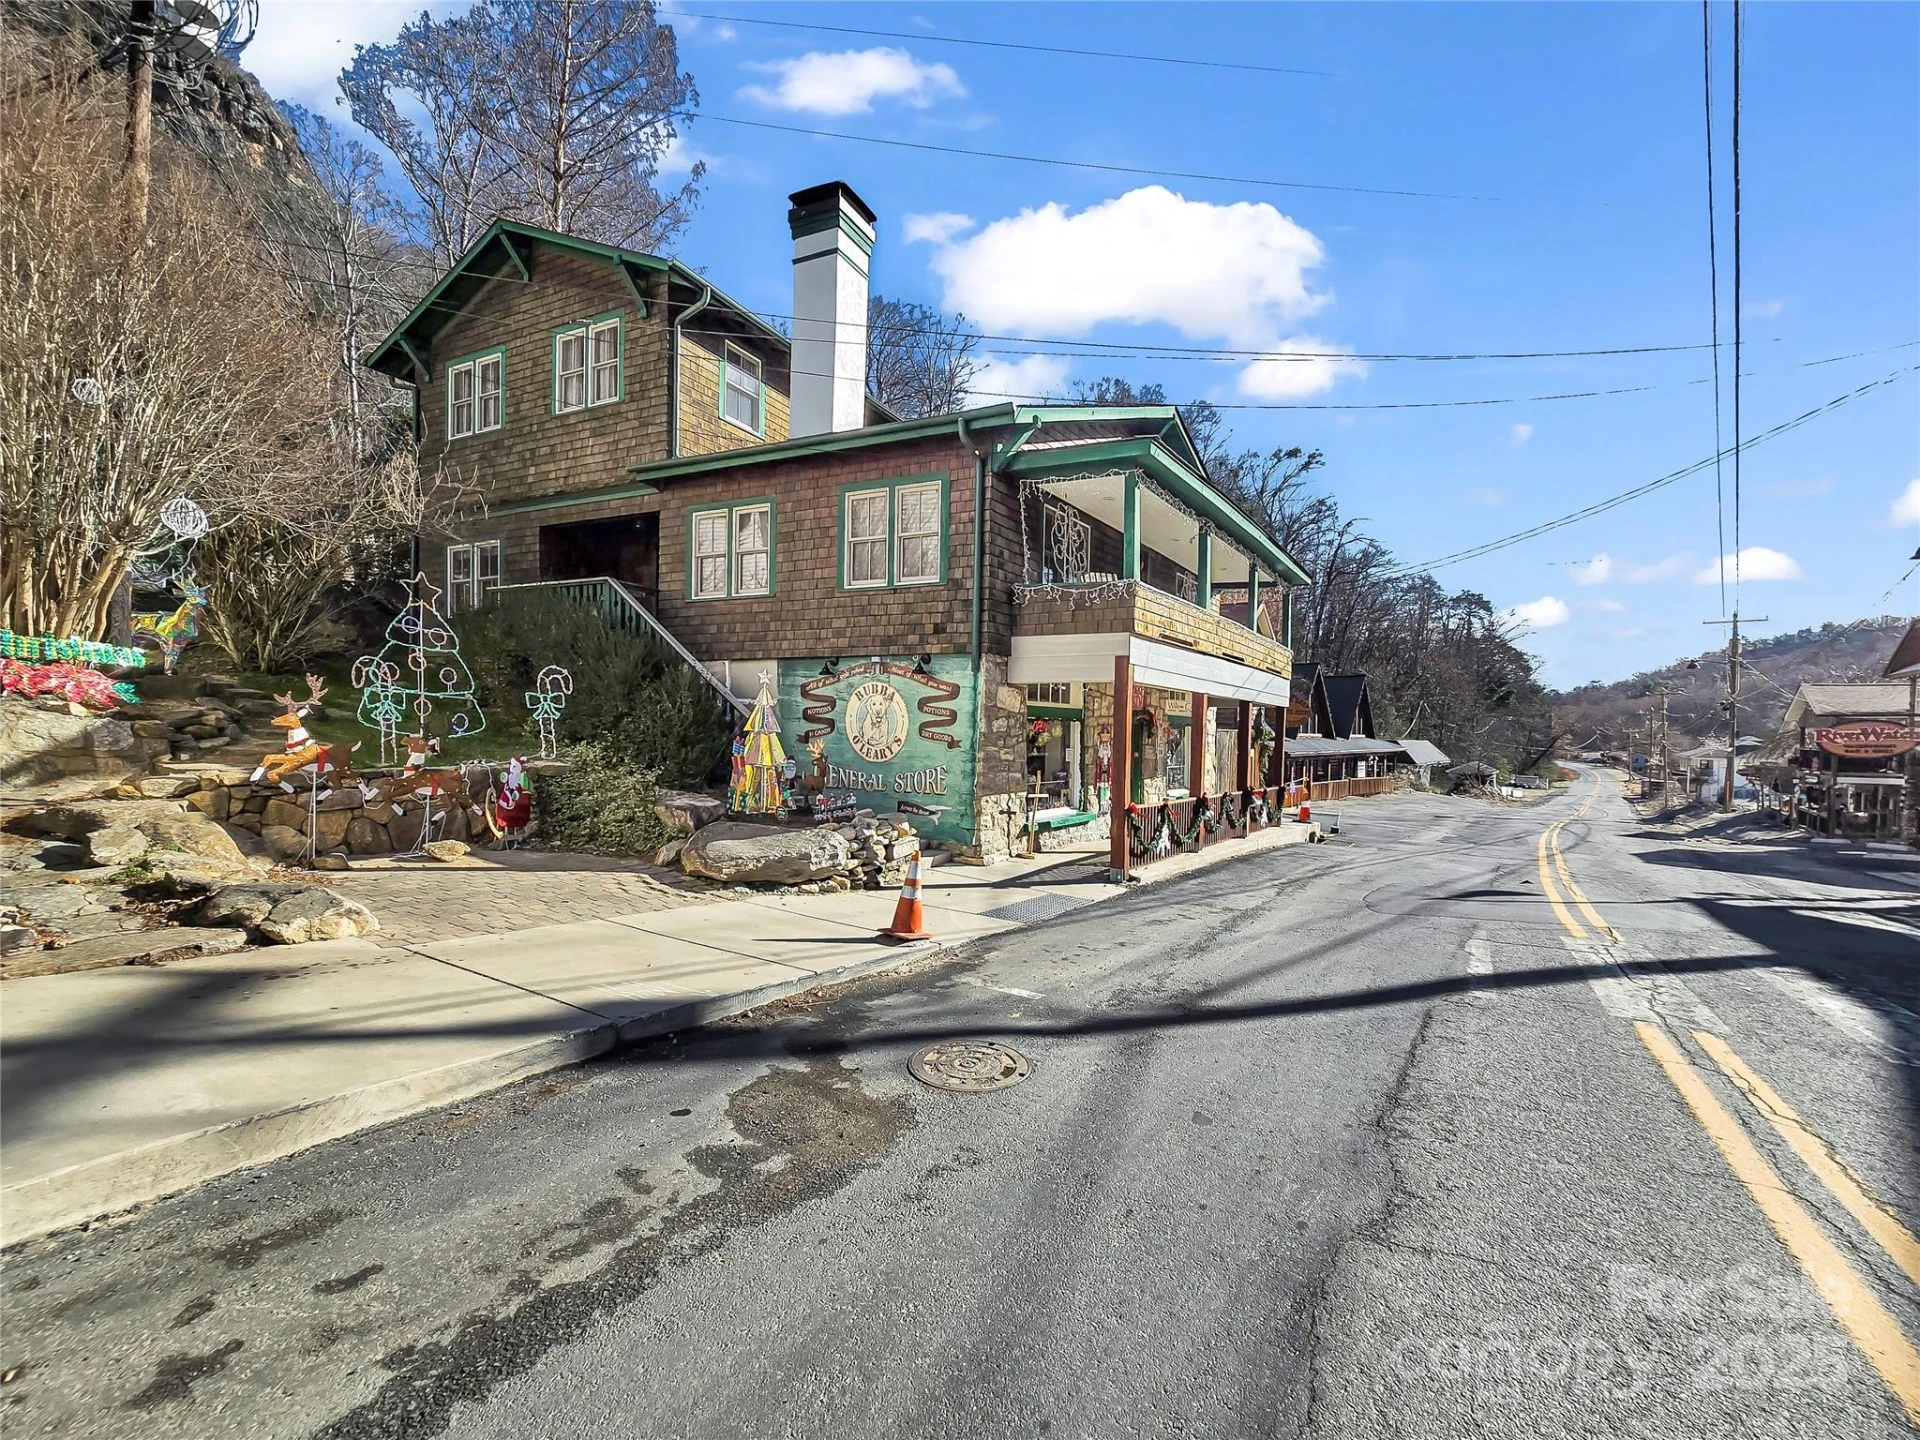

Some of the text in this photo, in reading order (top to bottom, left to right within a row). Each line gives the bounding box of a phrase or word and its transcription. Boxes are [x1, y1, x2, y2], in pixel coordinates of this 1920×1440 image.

[855, 684, 895, 702] BUBBA
[807, 705, 832, 715] NOTIONS
[923, 706, 950, 716] POTIONS
[814, 727, 832, 736] CANDY
[933, 732, 952, 742] GOODS
[852, 735, 903, 760] O'LEARY'S
[826, 763, 949, 796] ENERAL STORE
